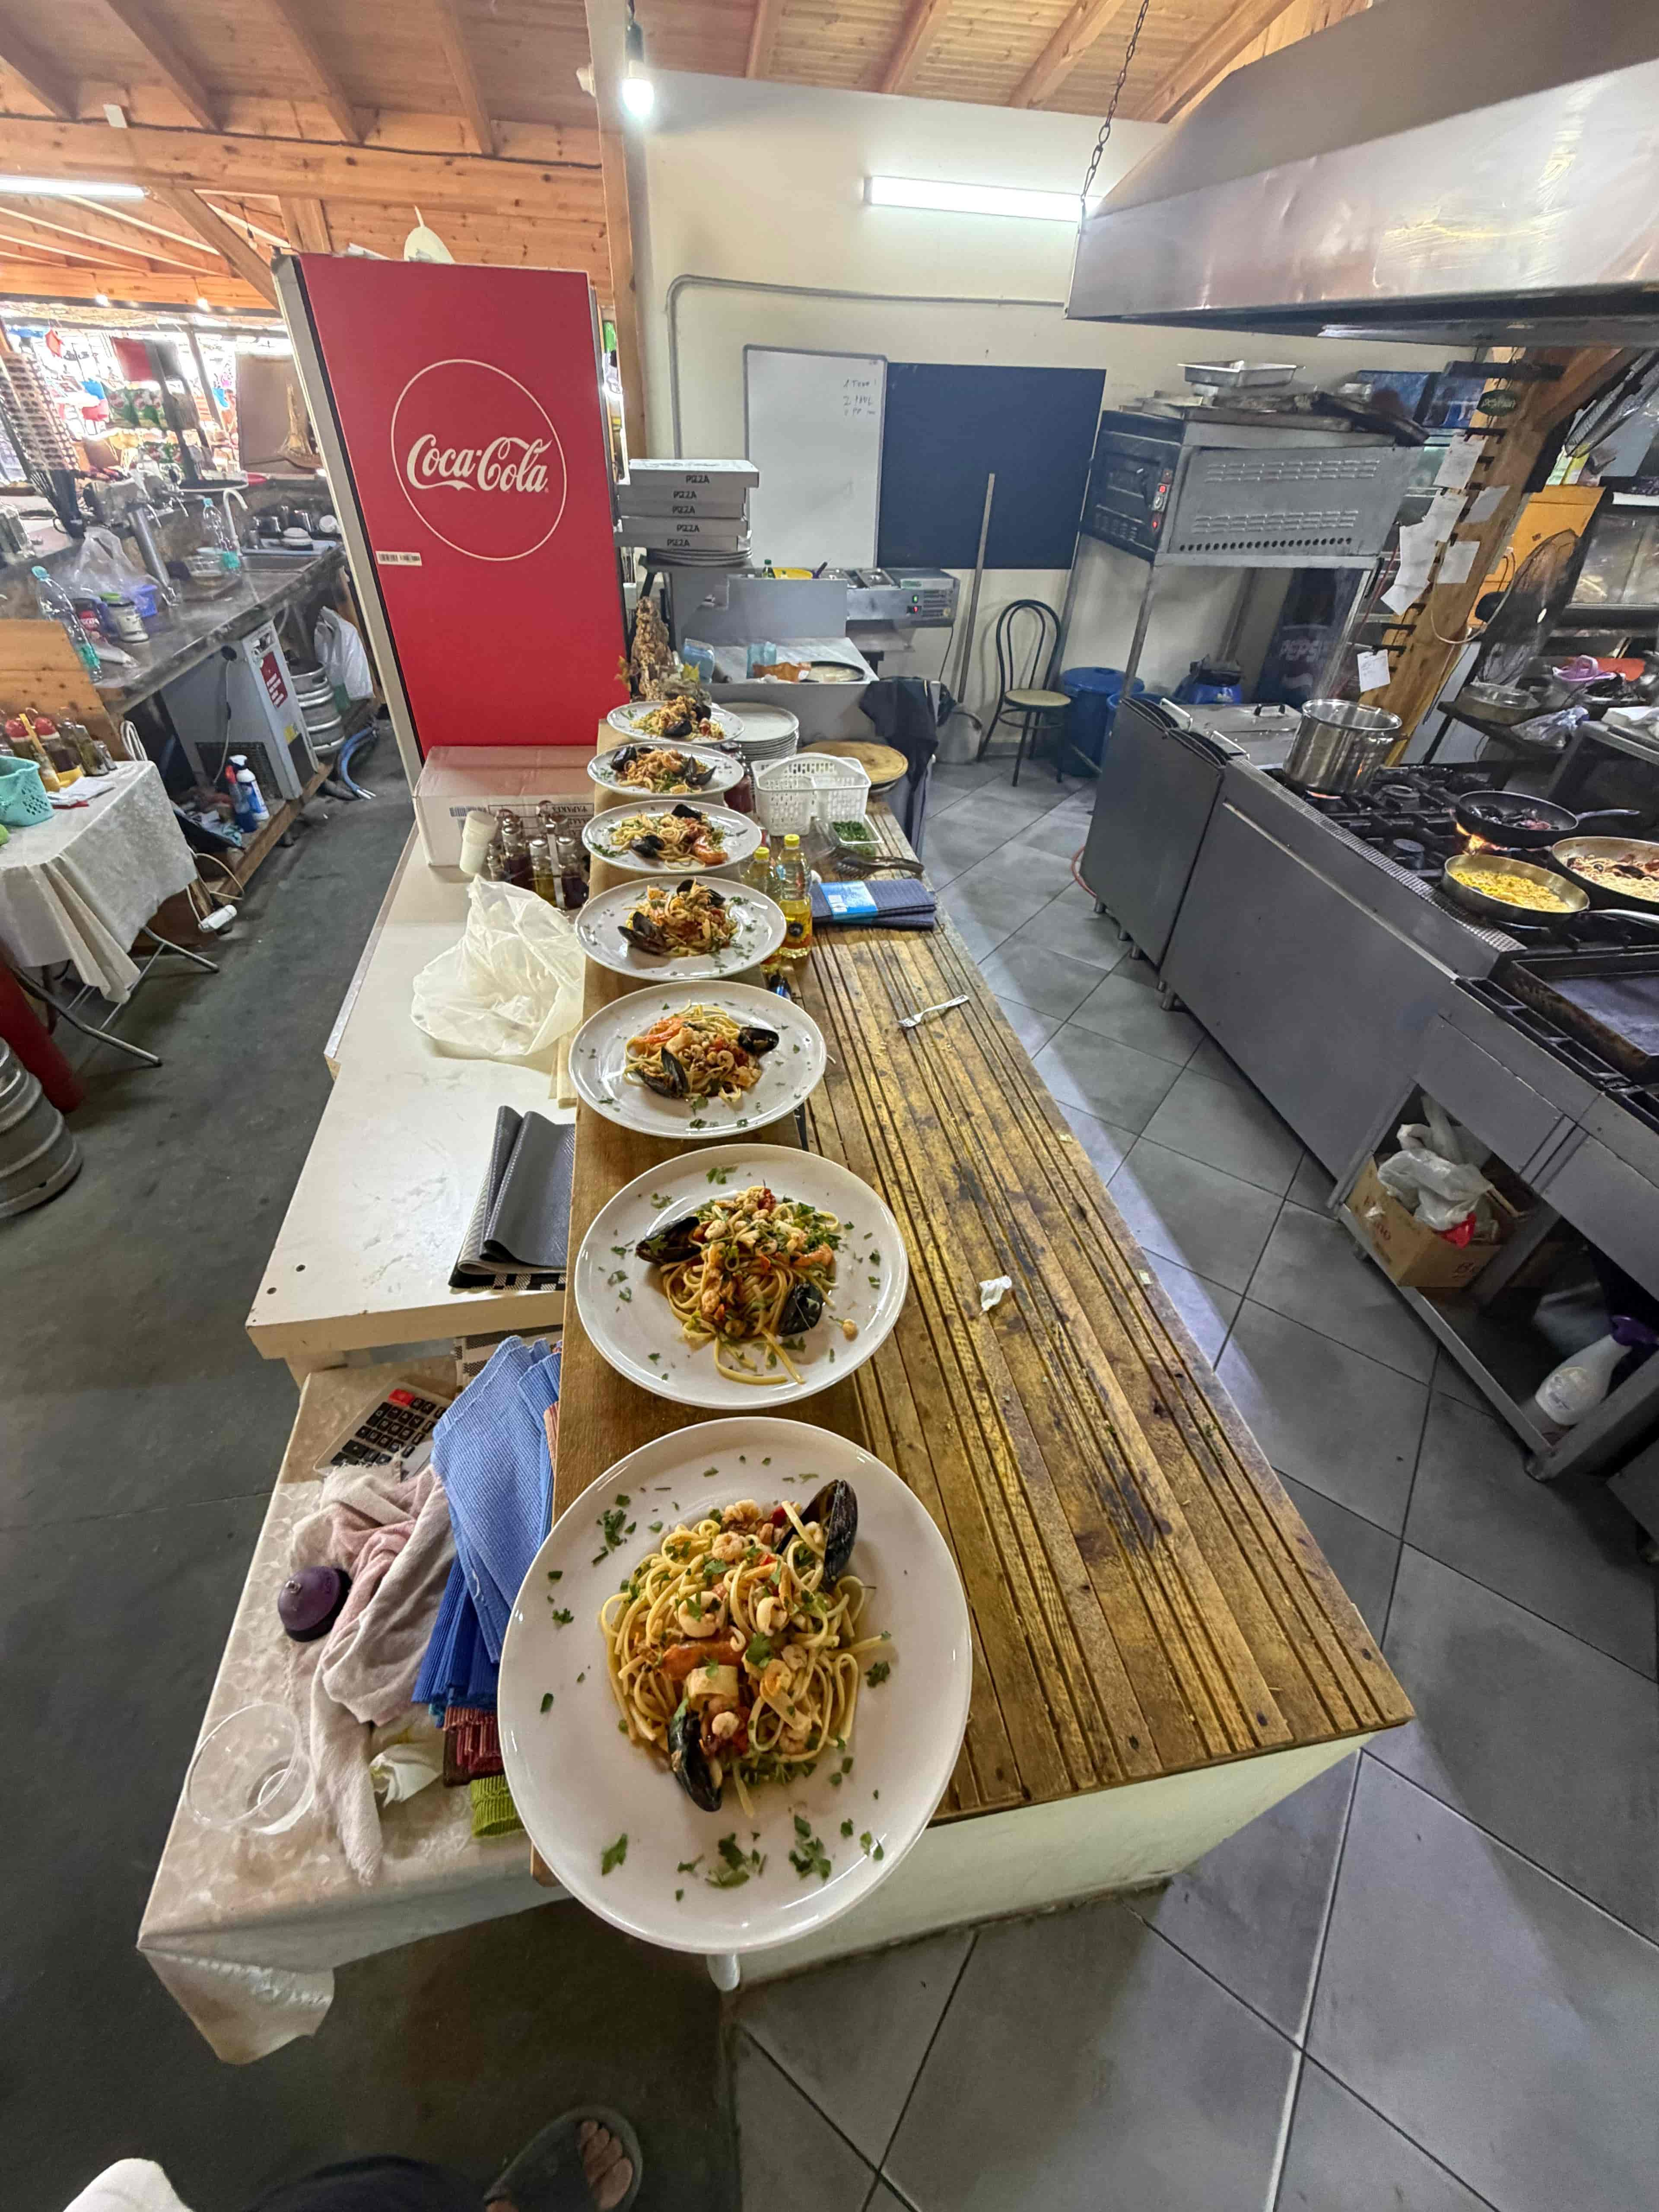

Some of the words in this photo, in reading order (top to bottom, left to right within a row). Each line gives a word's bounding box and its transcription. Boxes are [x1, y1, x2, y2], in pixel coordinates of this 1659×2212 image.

[407, 434, 552, 493] Coca-Cola
[686, 475, 710, 484] PIZZA
[674, 490, 697, 499] PIZZA
[672, 505, 695, 514] PIZZA
[677, 524, 700, 533] PIZZA
[667, 538, 690, 547] PIZZA
